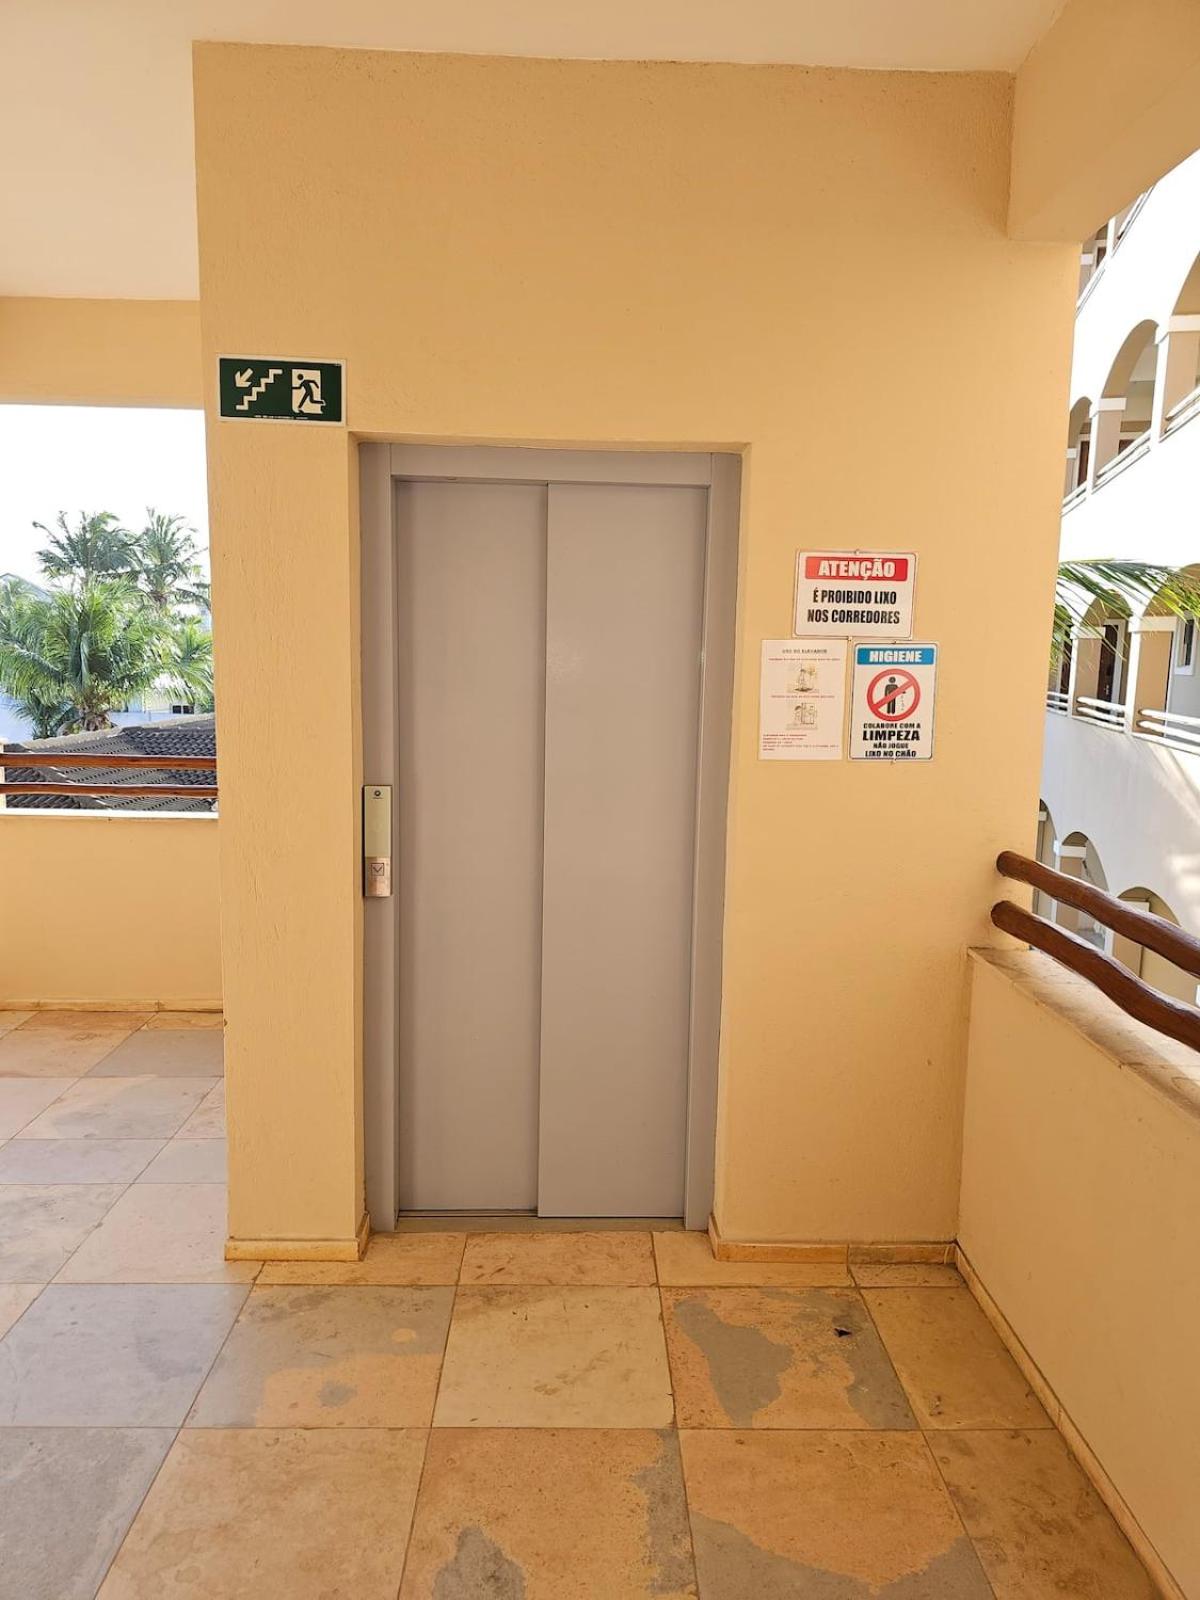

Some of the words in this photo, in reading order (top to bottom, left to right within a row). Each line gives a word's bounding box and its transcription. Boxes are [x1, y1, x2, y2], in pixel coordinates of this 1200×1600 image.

[818, 558, 896, 580] ATENÇÃO
[813, 587, 819, 603] É
[821, 589, 872, 604] PROIBIDO
[874, 591, 897, 605] LIXO
[807, 609, 829, 623] NOS
[831, 609, 900, 624] CORREDORES
[869, 650, 922, 663] HIGIENE
[863, 730, 920, 741] LIMPEZA
[873, 741, 886, 749] NÃO
[895, 749, 917, 757] CHÃO
